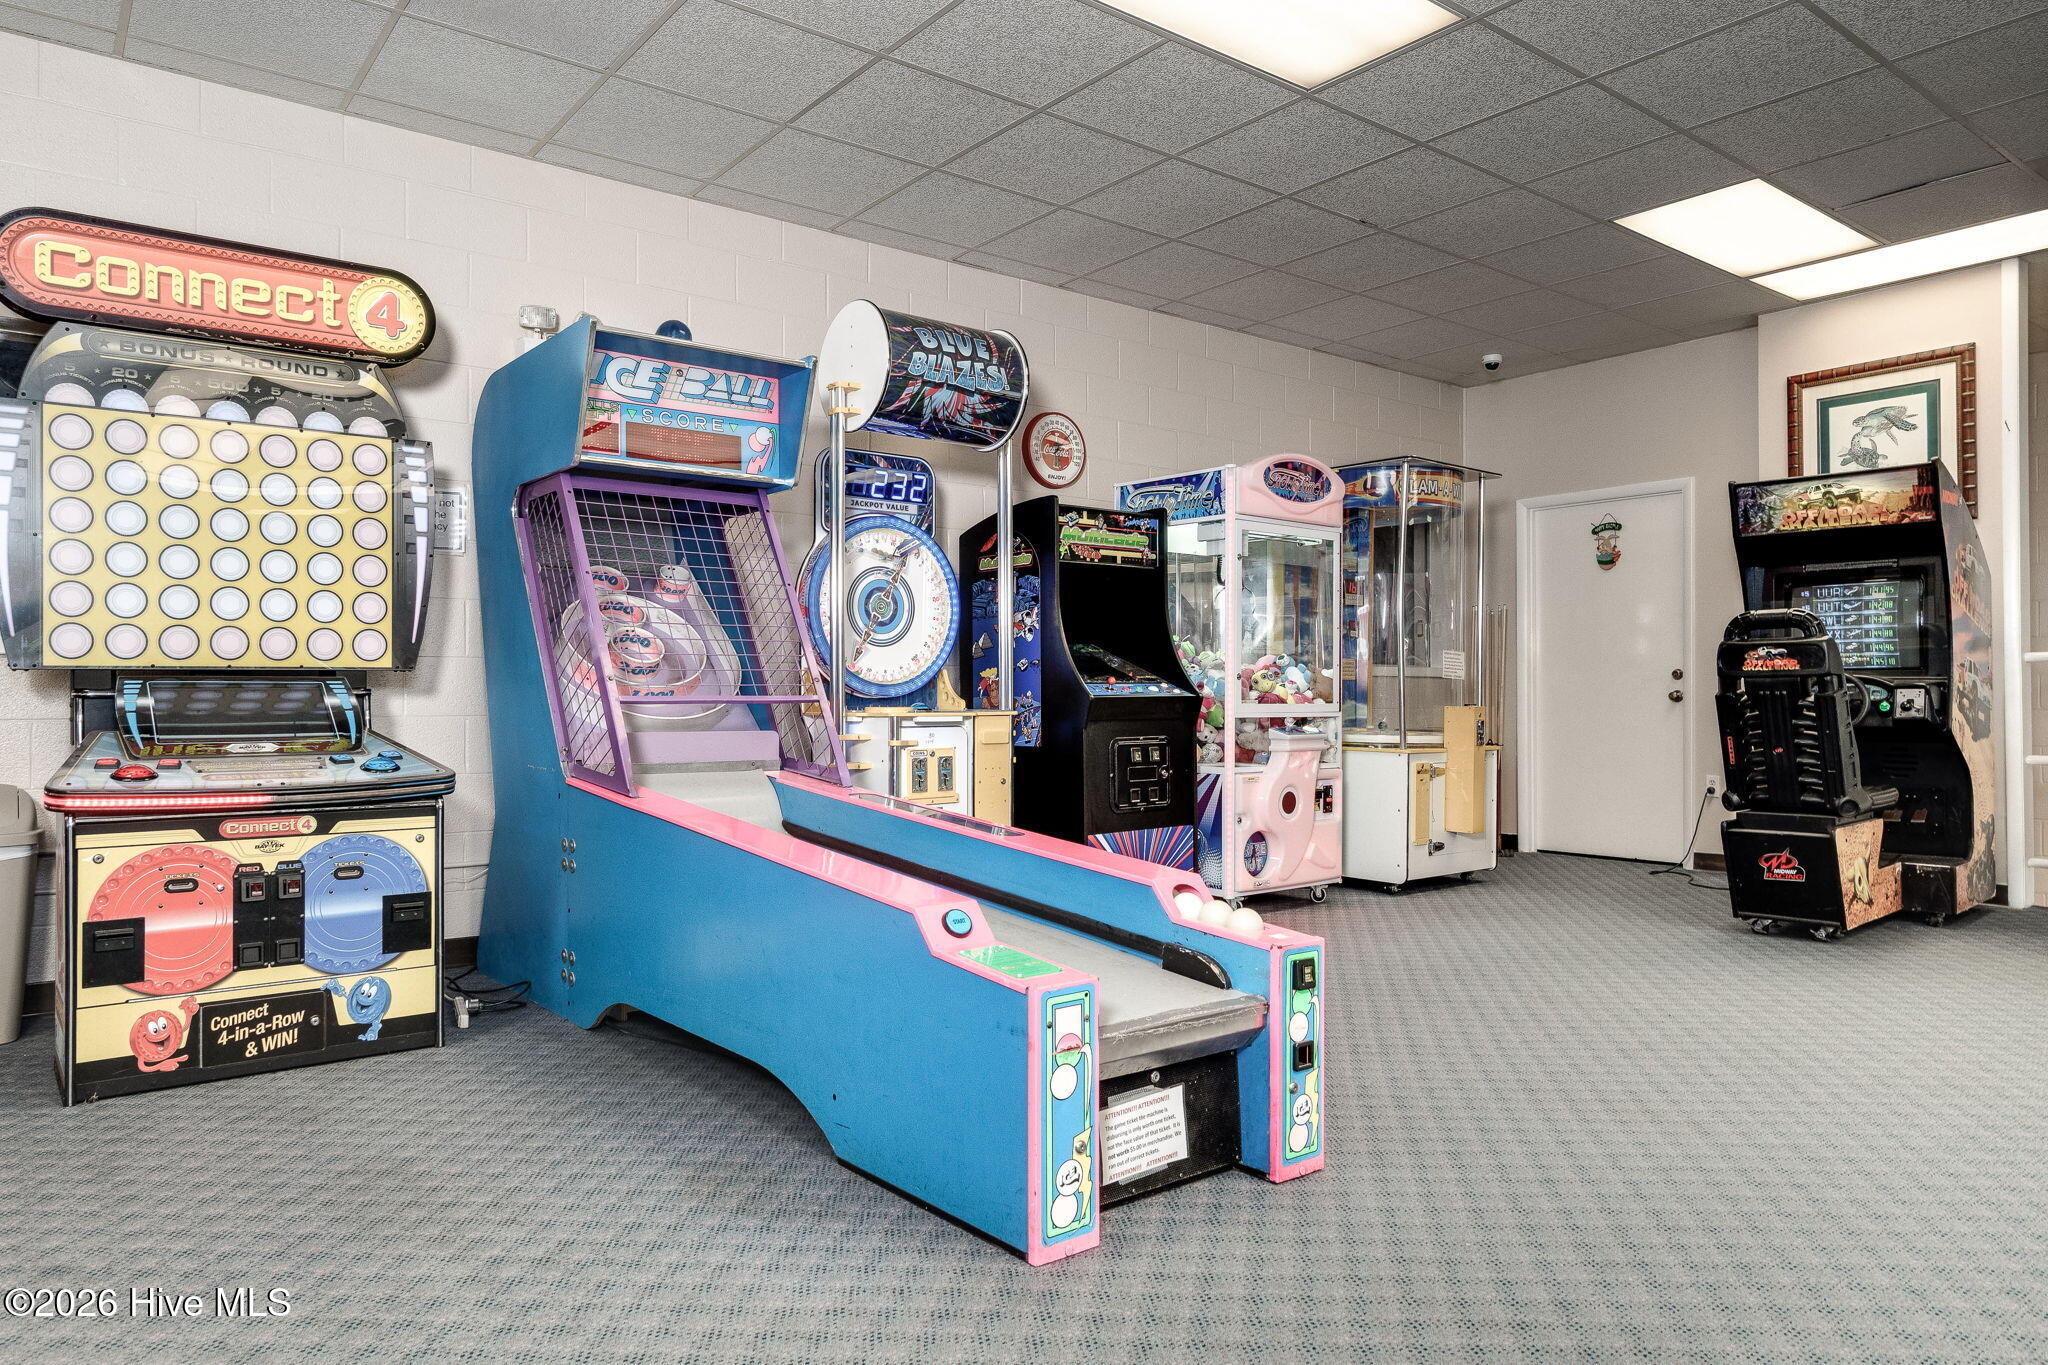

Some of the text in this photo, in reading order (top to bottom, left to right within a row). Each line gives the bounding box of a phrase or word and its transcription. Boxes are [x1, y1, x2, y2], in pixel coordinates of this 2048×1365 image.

[34, 240, 408, 339] Connect 4
[913, 327, 991, 360] BLUE
[119, 339, 328, 377] BONUS ROUND
[112, 367, 139, 379] 20
[907, 352, 1011, 392] BLAZES!
[591, 351, 672, 404] ICE
[679, 366, 776, 410] BALL
[270, 387, 282, 396] 5
[311, 393, 334, 402] 20
[586, 400, 725, 432] ALLS SCORE
[586, 411, 613, 421] EFT
[850, 500, 909, 512] JACKPOT VALUE
[1060, 525, 1149, 547] Multicade
[226, 818, 313, 834] Connect 4
[333, 860, 366, 868] TICKETS
[164, 872, 200, 880] TICKETS
[1766, 872, 1804, 880] RACING
[210, 1002, 269, 1032] Connect
[217, 1009, 306, 1046] 4-in-a-Row
[245, 1027, 299, 1058] & WIN!
[1114, 1122, 1126, 1131] game
[1127, 1116, 1138, 1124] ticket
[1146, 1109, 1164, 1118] machine
[1133, 1125, 1142, 1133] only
[1142, 1121, 1155, 1129] worth
[1133, 1134, 1144, 1142] value
[1116, 1149, 1129, 1157] worth
[1130, 1143, 1142, 1153] $5.00
[1130, 1152, 1145, 1162] correct
